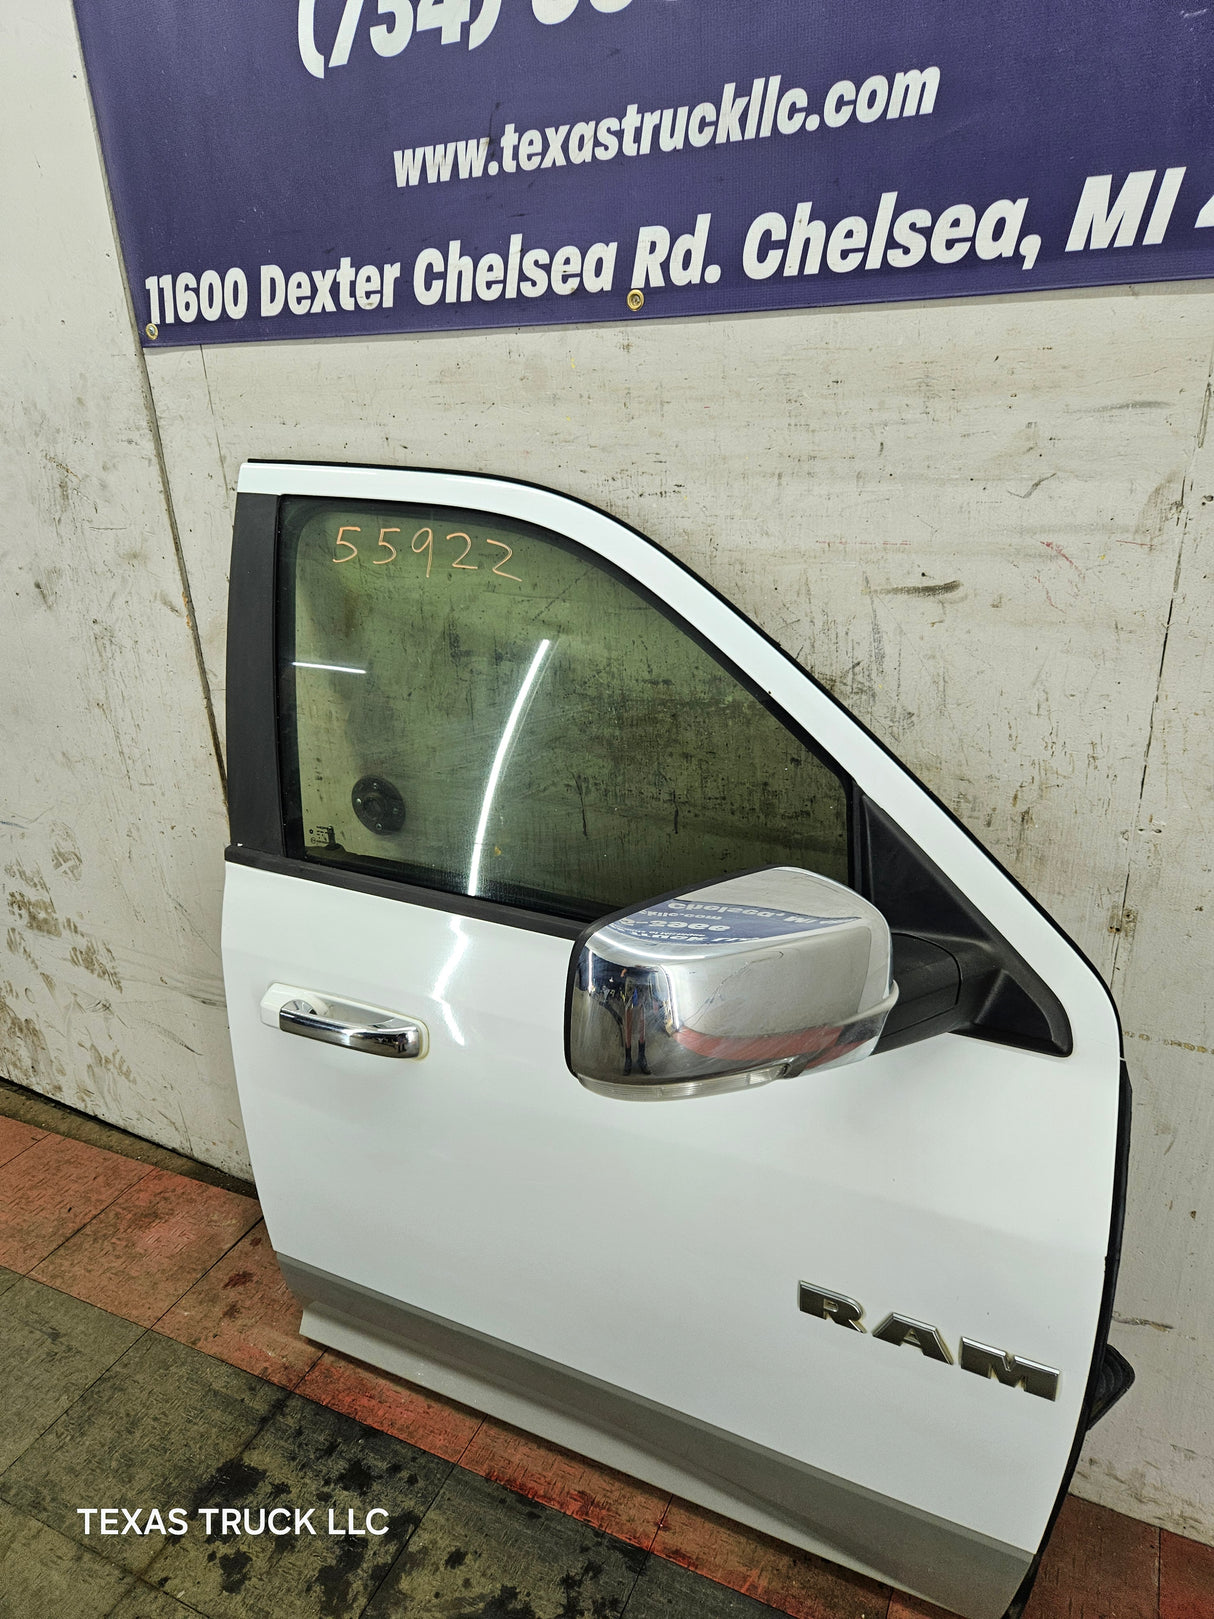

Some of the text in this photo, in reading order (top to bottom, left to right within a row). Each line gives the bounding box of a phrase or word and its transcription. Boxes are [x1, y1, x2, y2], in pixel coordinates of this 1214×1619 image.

[393, 66, 940, 188] www.texastruckllc.com
[145, 267, 248, 325] 11600
[260, 256, 400, 318] Dexter
[413, 233, 618, 306] Chelsea
[631, 213, 722, 289] Rd.
[742, 191, 1042, 281] Chelsea,
[1065, 166, 1187, 252] MI
[333, 526, 523, 582] 55922
[797, 1280, 1060, 1401] RAM
